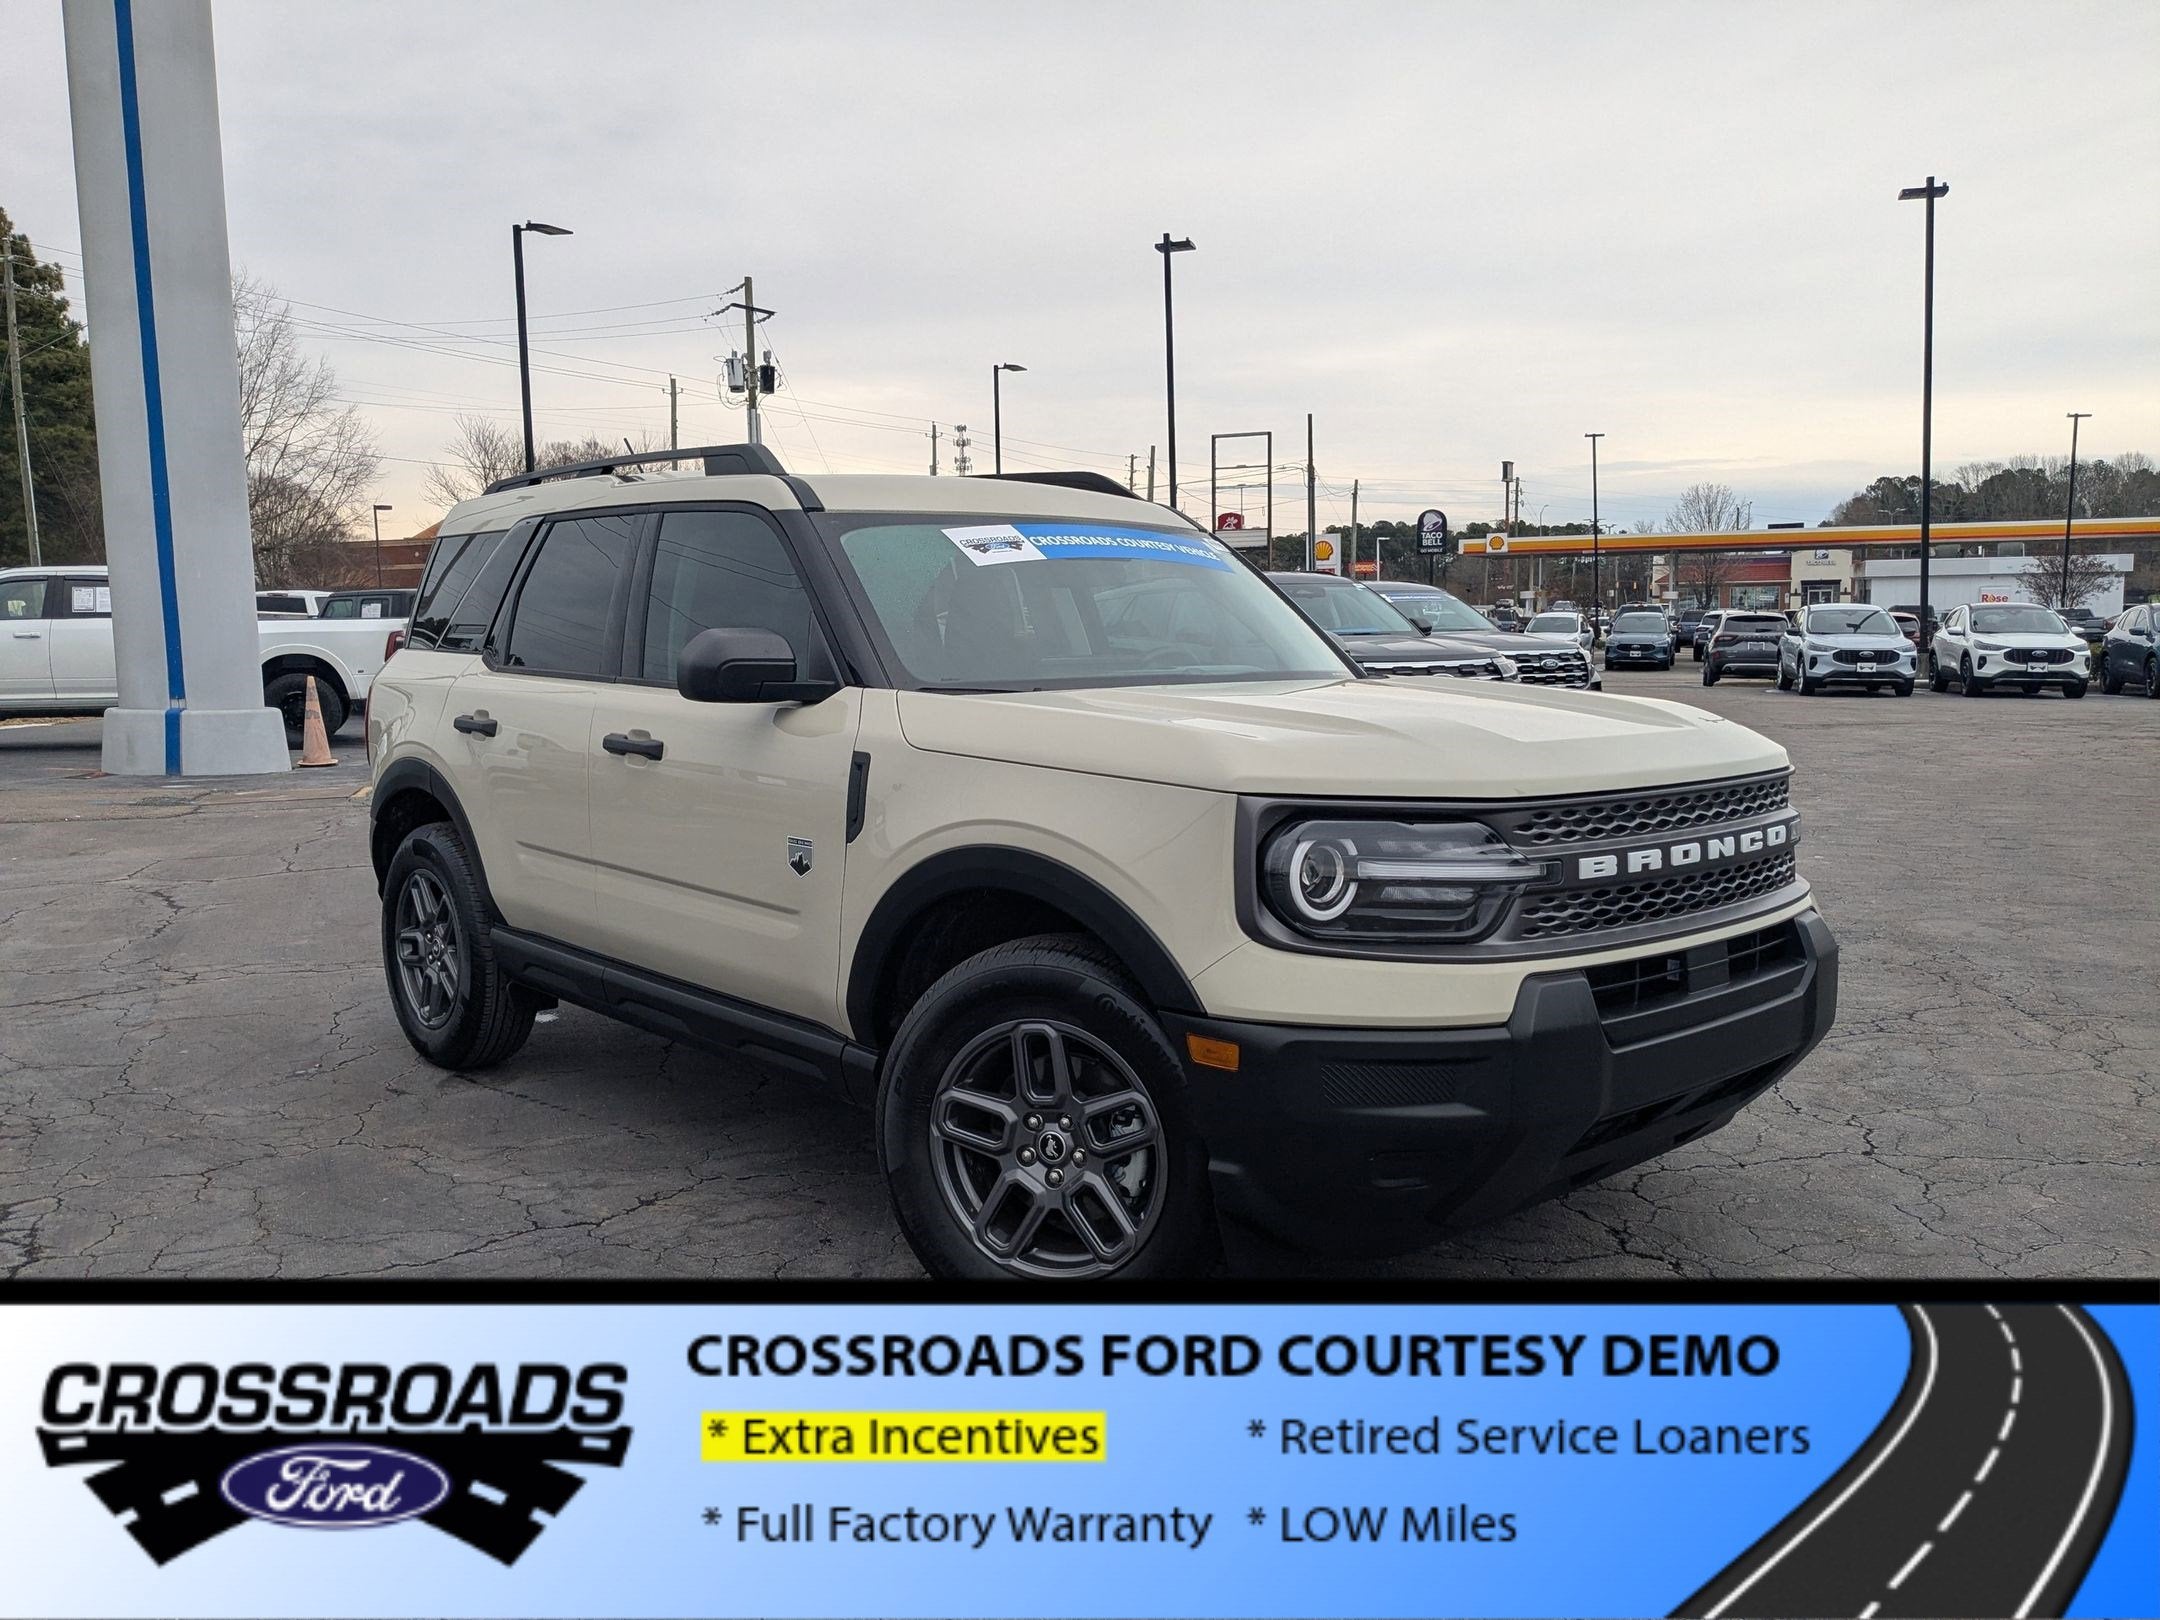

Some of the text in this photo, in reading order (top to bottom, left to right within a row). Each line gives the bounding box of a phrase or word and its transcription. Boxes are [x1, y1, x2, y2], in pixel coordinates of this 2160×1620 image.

[959, 535, 1023, 546] CROSSROADS
[1421, 531, 1443, 539] TACO
[1030, 536, 1118, 547] CROSSROADS
[1117, 538, 1176, 552] COURTESY
[1981, 593, 2009, 603] Rose
[1578, 824, 1787, 880] BRONCO
